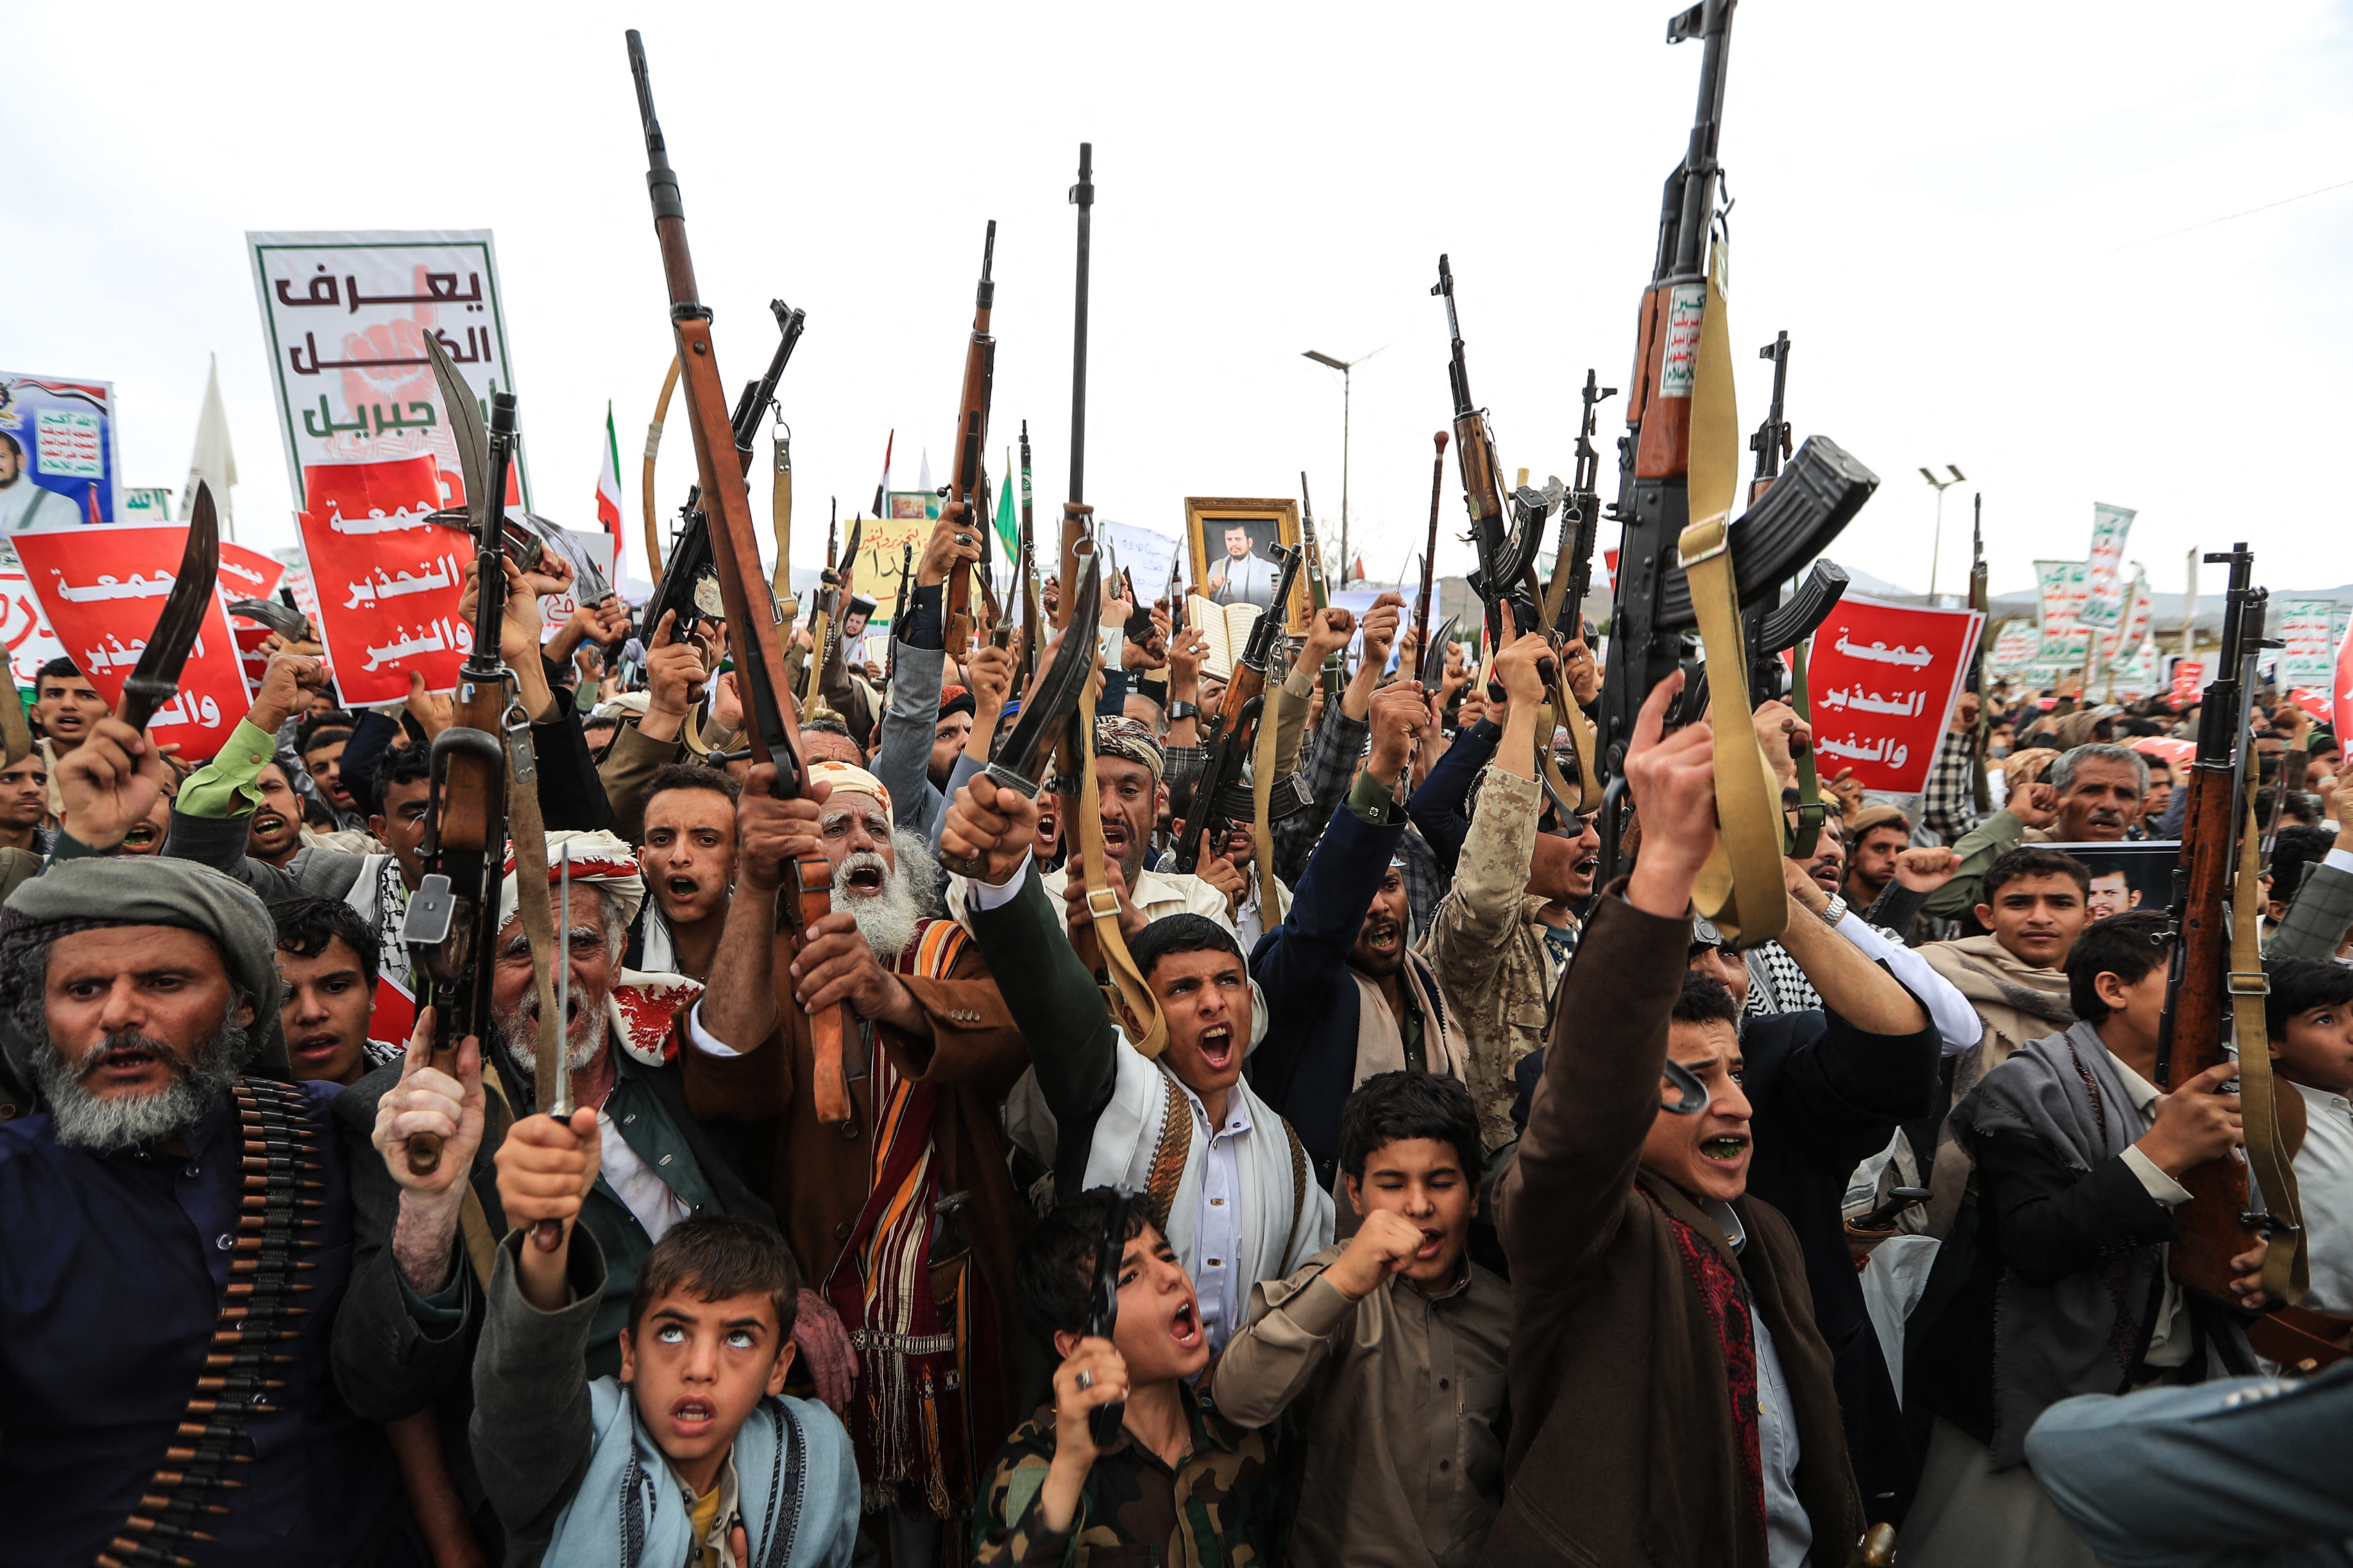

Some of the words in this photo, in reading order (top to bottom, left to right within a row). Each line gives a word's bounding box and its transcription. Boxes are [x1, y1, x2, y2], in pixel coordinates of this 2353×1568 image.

[275, 263, 483, 314] يعرف
[302, 394, 436, 439] جبريل
[326, 499, 437, 534] جمعة
[50, 567, 177, 602] جمعة
[342, 552, 460, 610] التحذير
[361, 615, 473, 672] والنفير
[1834, 626, 1935, 672] جمعة
[1818, 683, 1927, 718] التحذير
[1814, 732, 1909, 770] والنفير
